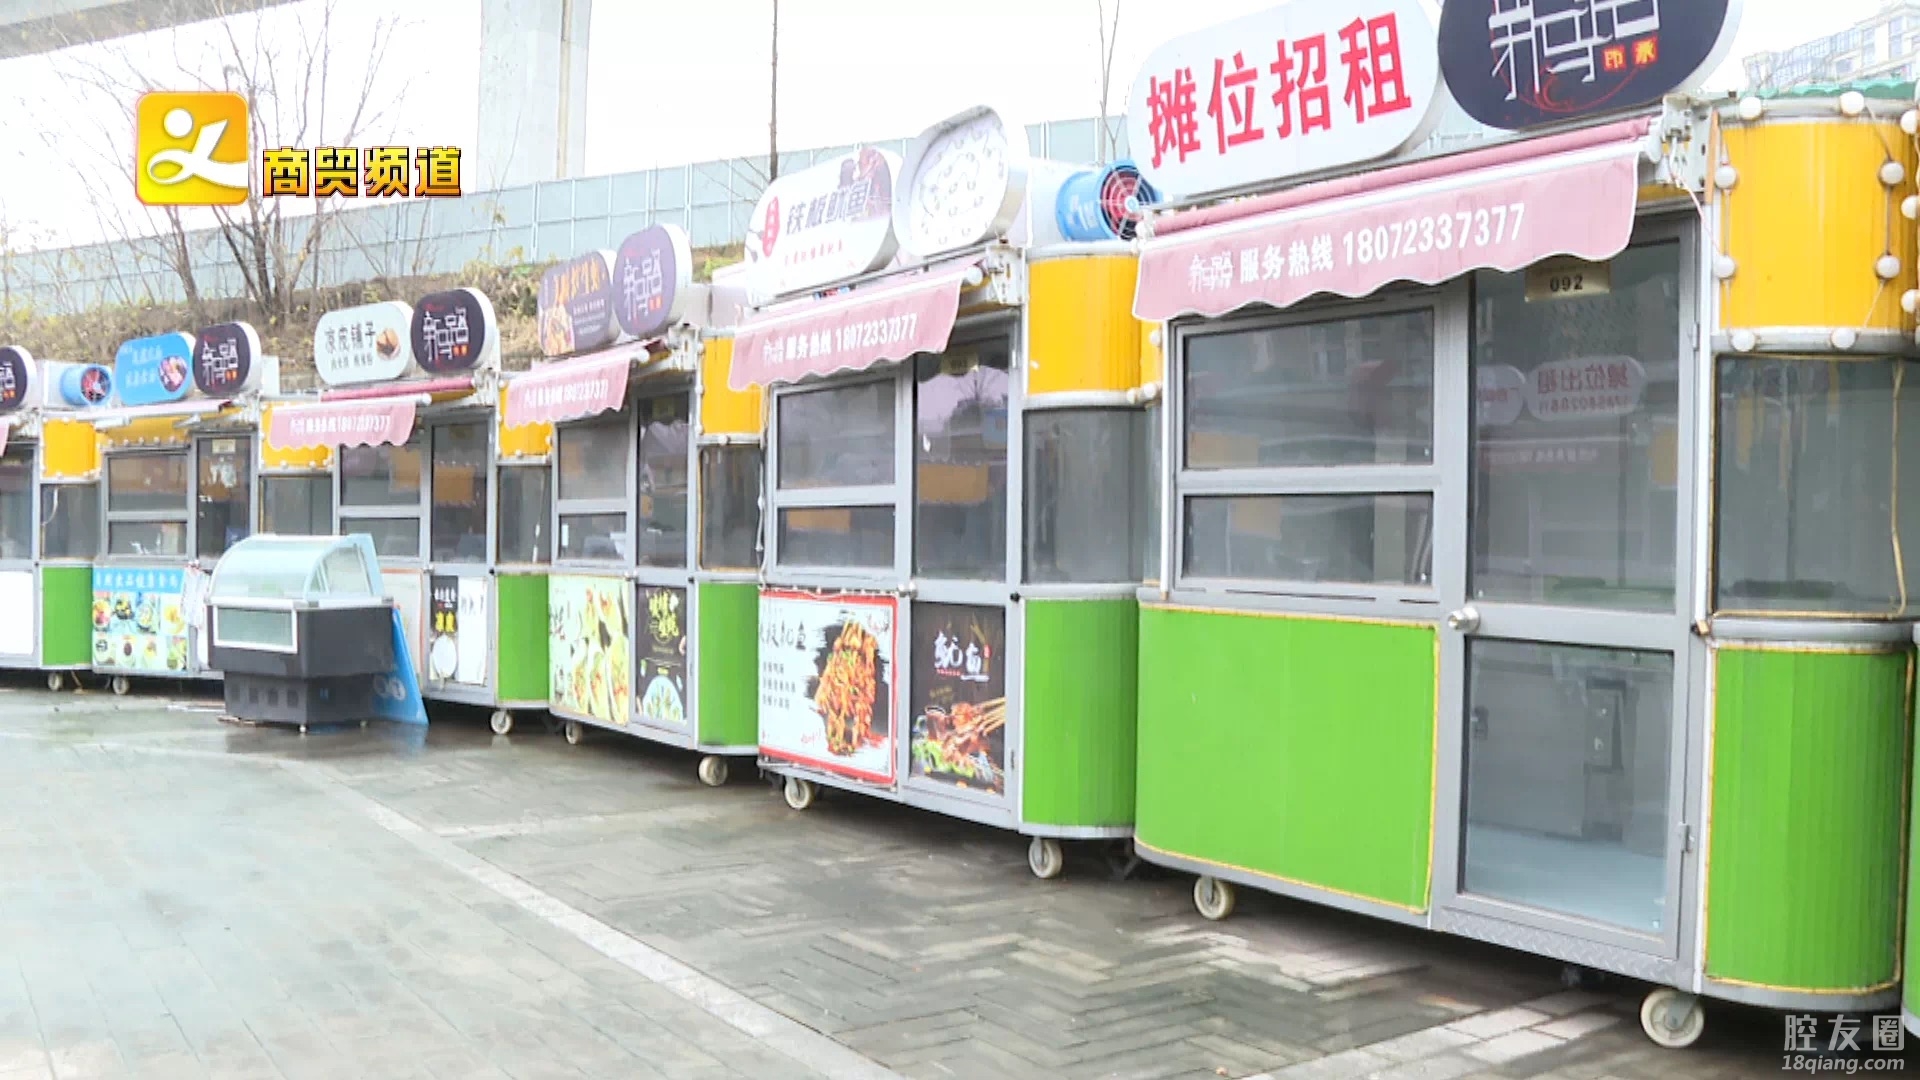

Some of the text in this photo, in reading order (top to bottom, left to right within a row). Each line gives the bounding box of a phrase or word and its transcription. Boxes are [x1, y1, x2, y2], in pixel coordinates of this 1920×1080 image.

[1147, 11, 1411, 169] 摊位招租
[1240, 237, 1334, 283] 服务热线
[1344, 203, 1526, 266] 18072337377
[1549, 273, 1583, 292] 092
[836, 313, 917, 353] 18072337377
